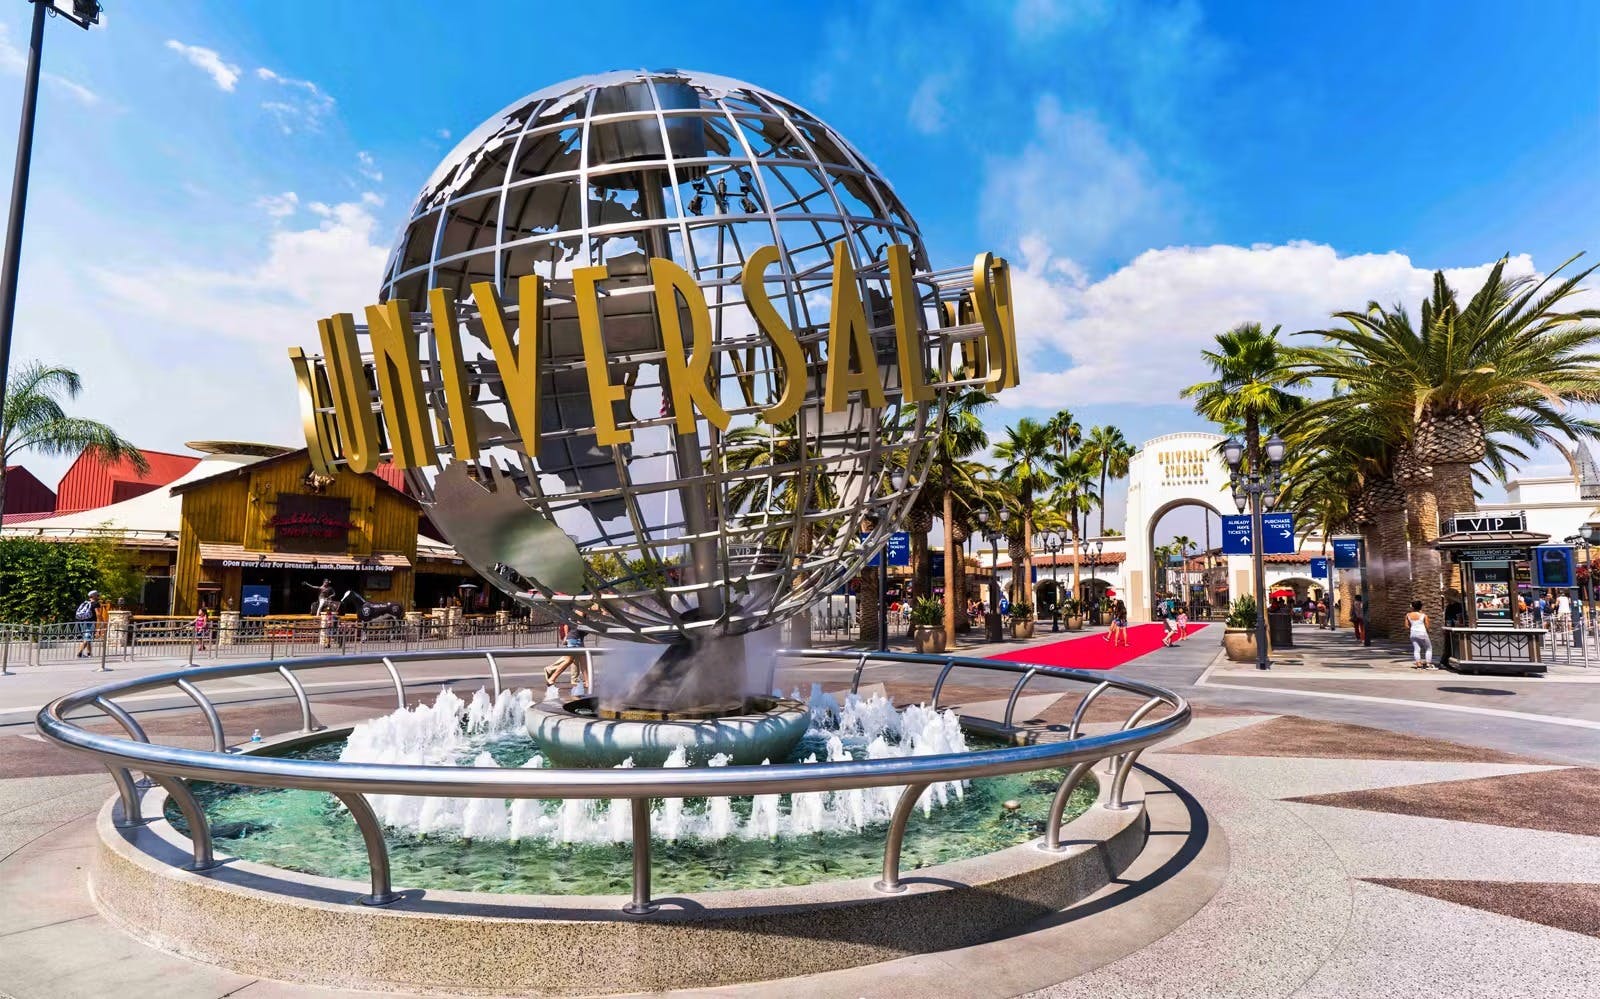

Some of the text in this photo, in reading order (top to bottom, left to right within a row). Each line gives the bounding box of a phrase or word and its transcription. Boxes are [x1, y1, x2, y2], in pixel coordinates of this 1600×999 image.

[317, 241, 935, 474] UNIVERSAL
[1158, 449, 1210, 465] UNIVERSAL
[1165, 464, 1203, 478] STUDIOS
[1470, 518, 1504, 531] VIP
